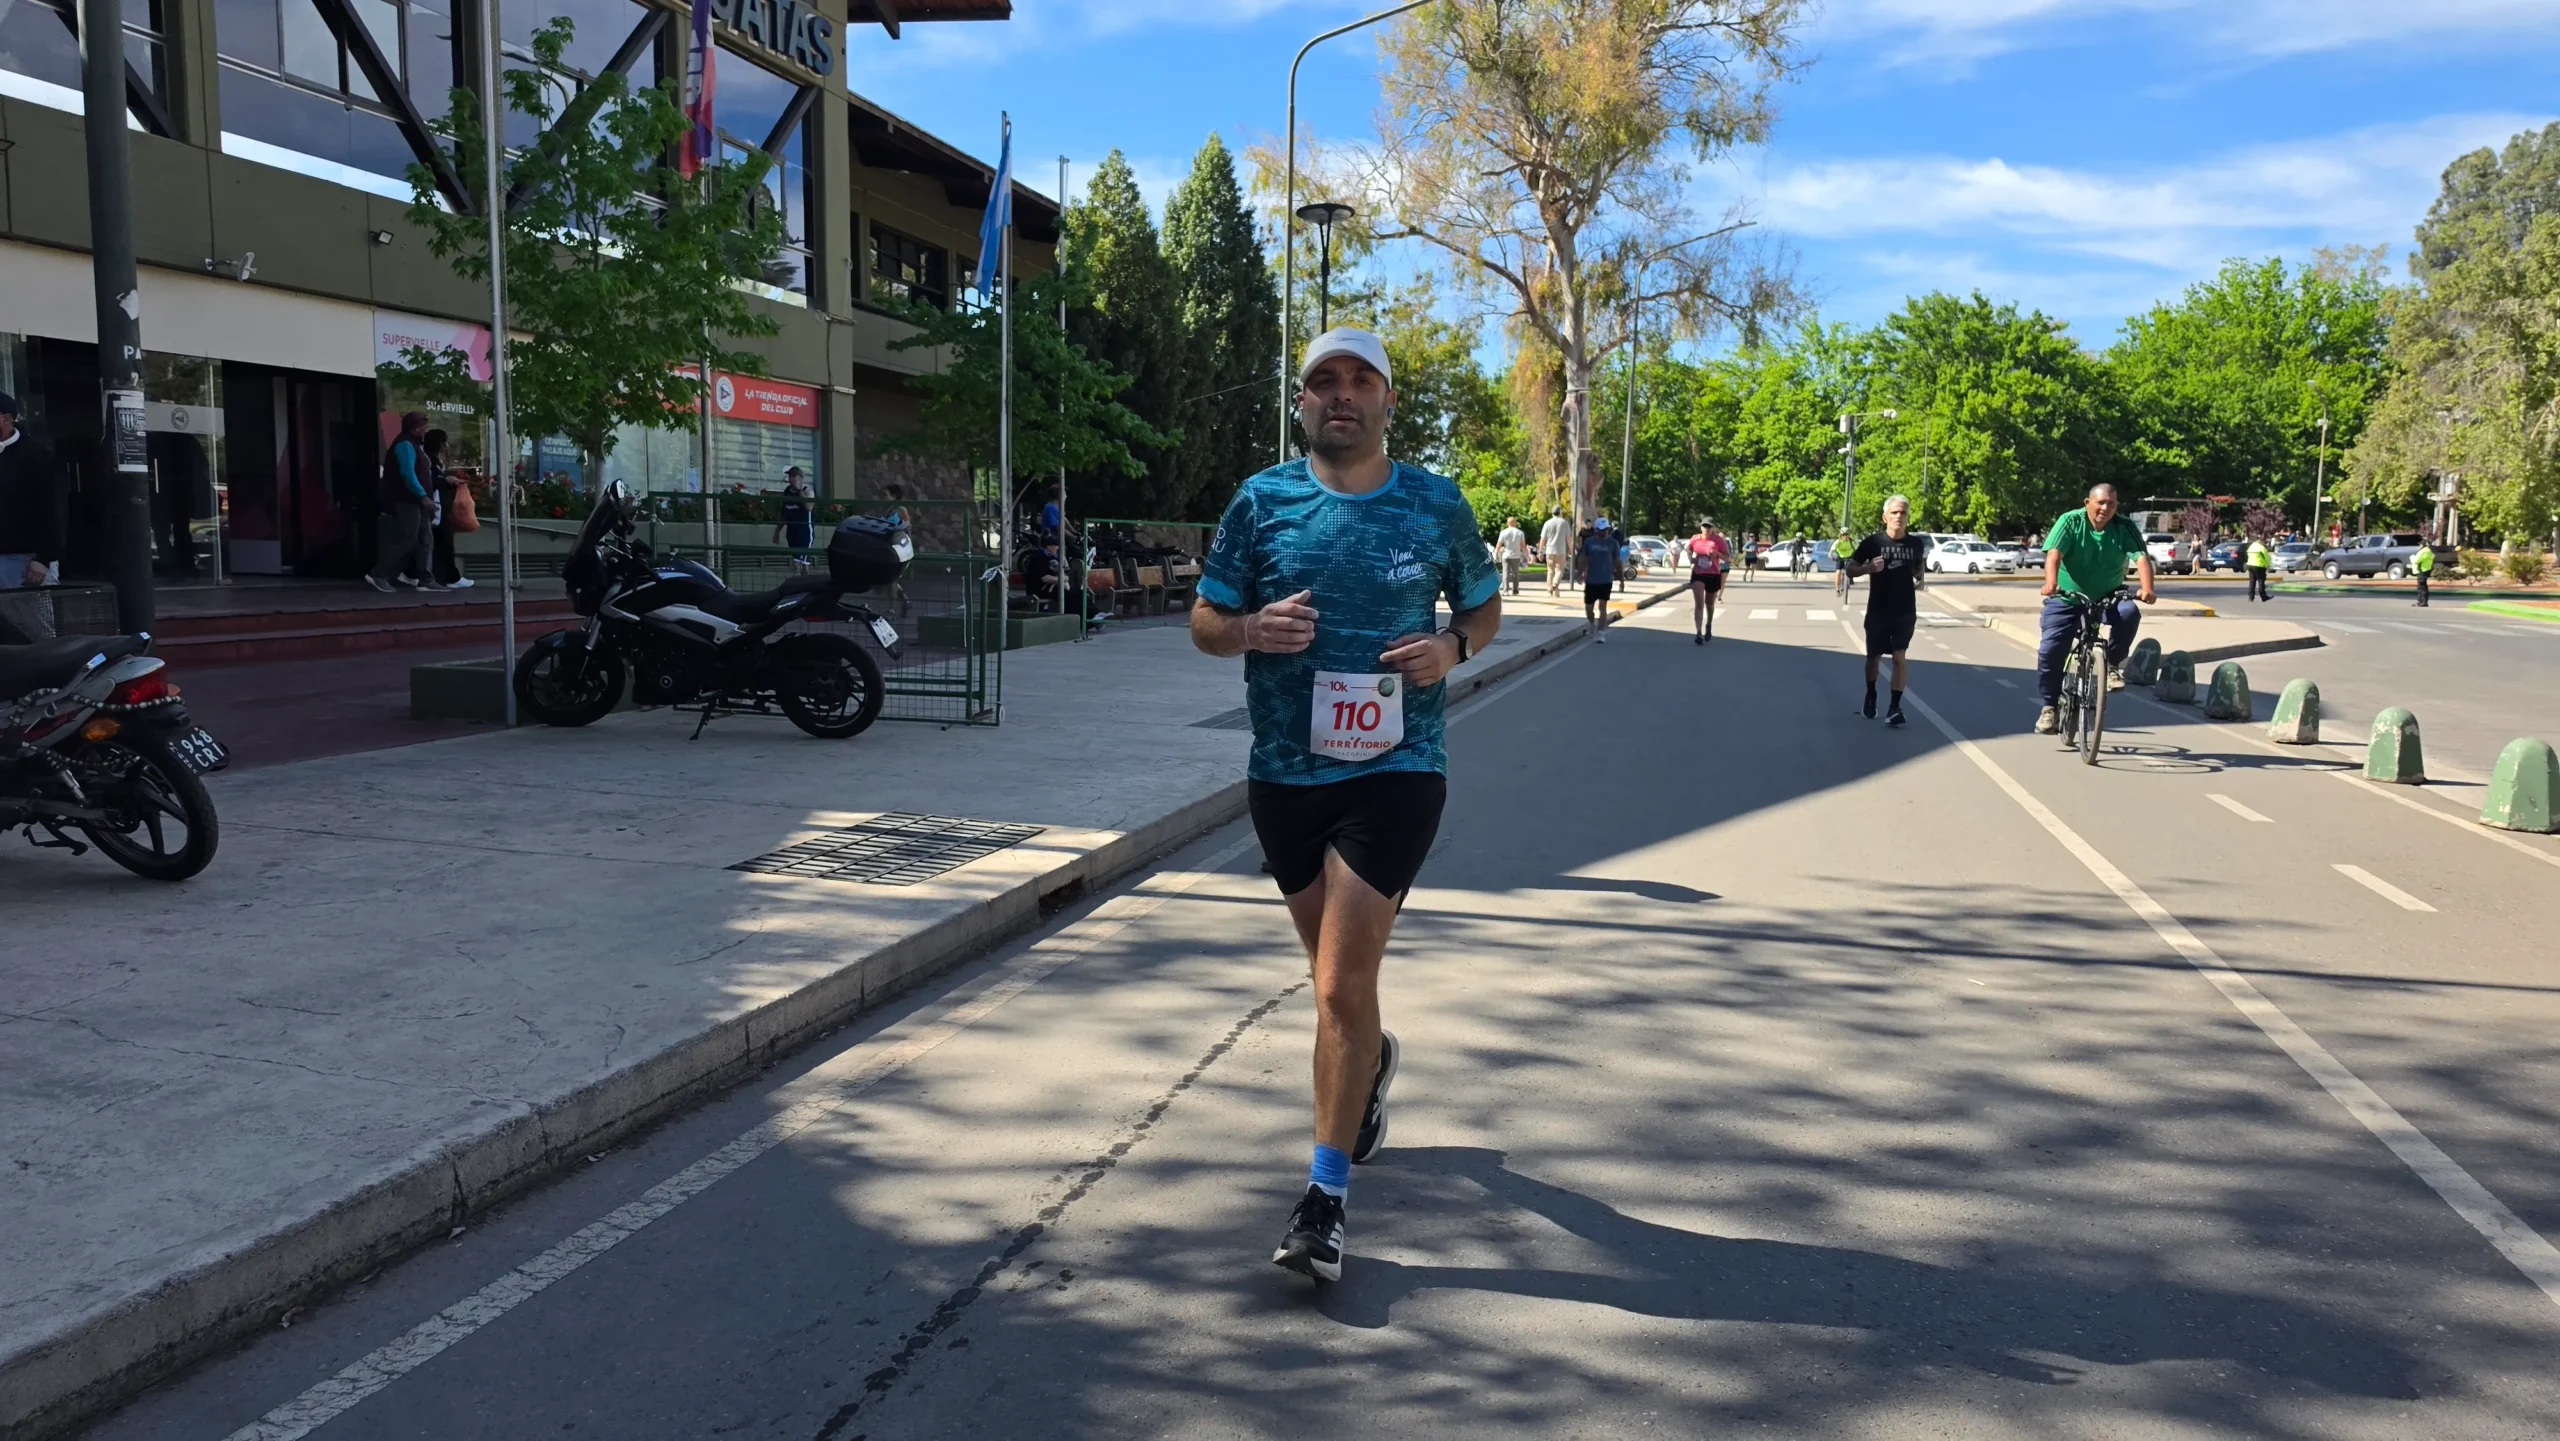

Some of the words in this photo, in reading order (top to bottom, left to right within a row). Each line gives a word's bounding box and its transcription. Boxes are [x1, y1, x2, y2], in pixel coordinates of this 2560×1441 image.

[382, 332, 440, 351] SUPERVIELLE
[745, 389, 754, 400] LA
[755, 390, 782, 403] TIENDA
[783, 394, 808, 407] OFICIAL
[761, 403, 775, 412] DEL
[776, 405, 794, 415] CLUB
[1387, 568, 1396, 580] a
[1329, 681, 1348, 692] 10k
[1332, 700, 1381, 731] 110
[180, 729, 213, 754] 948
[1323, 736, 1391, 749] TERRITORIO
[194, 742, 225, 767] CRI
